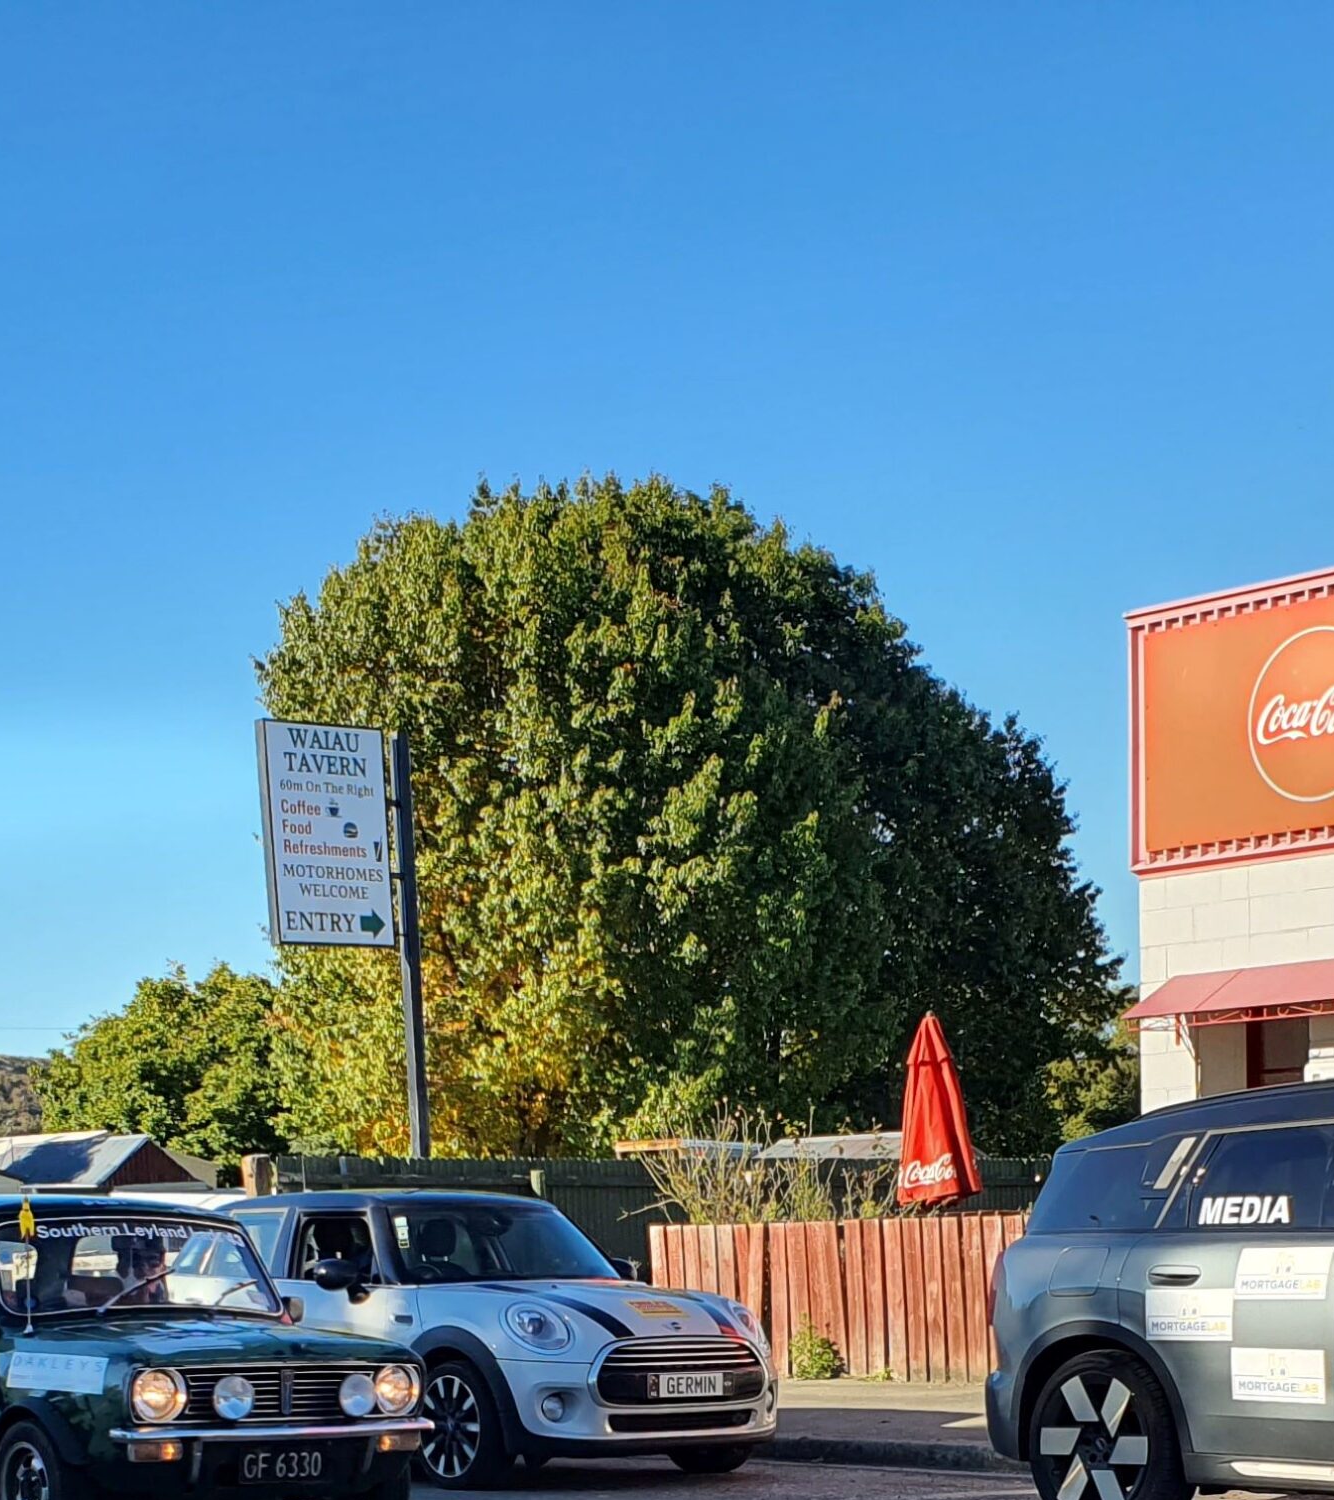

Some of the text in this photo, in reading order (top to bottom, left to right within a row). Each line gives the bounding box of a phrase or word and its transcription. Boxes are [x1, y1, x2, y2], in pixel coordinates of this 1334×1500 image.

[287, 727, 359, 752] WAIAU
[283, 752, 366, 778] TAVERN
[279, 779, 374, 799] 60m On The Right
[281, 799, 321, 815] Coffee
[282, 819, 312, 835] Food
[283, 839, 367, 858] Refreshments
[283, 863, 383, 882] MOTORHOMES
[299, 883, 369, 899] WELCOME
[285, 910, 355, 933] ENTRY
[1198, 1196, 1291, 1225] MEDIA
[37, 1222, 121, 1240] Southern
[125, 1223, 187, 1240] Leyland
[667, 1375, 717, 1395] GERMIN
[244, 1451, 322, 1478] GF 6330
